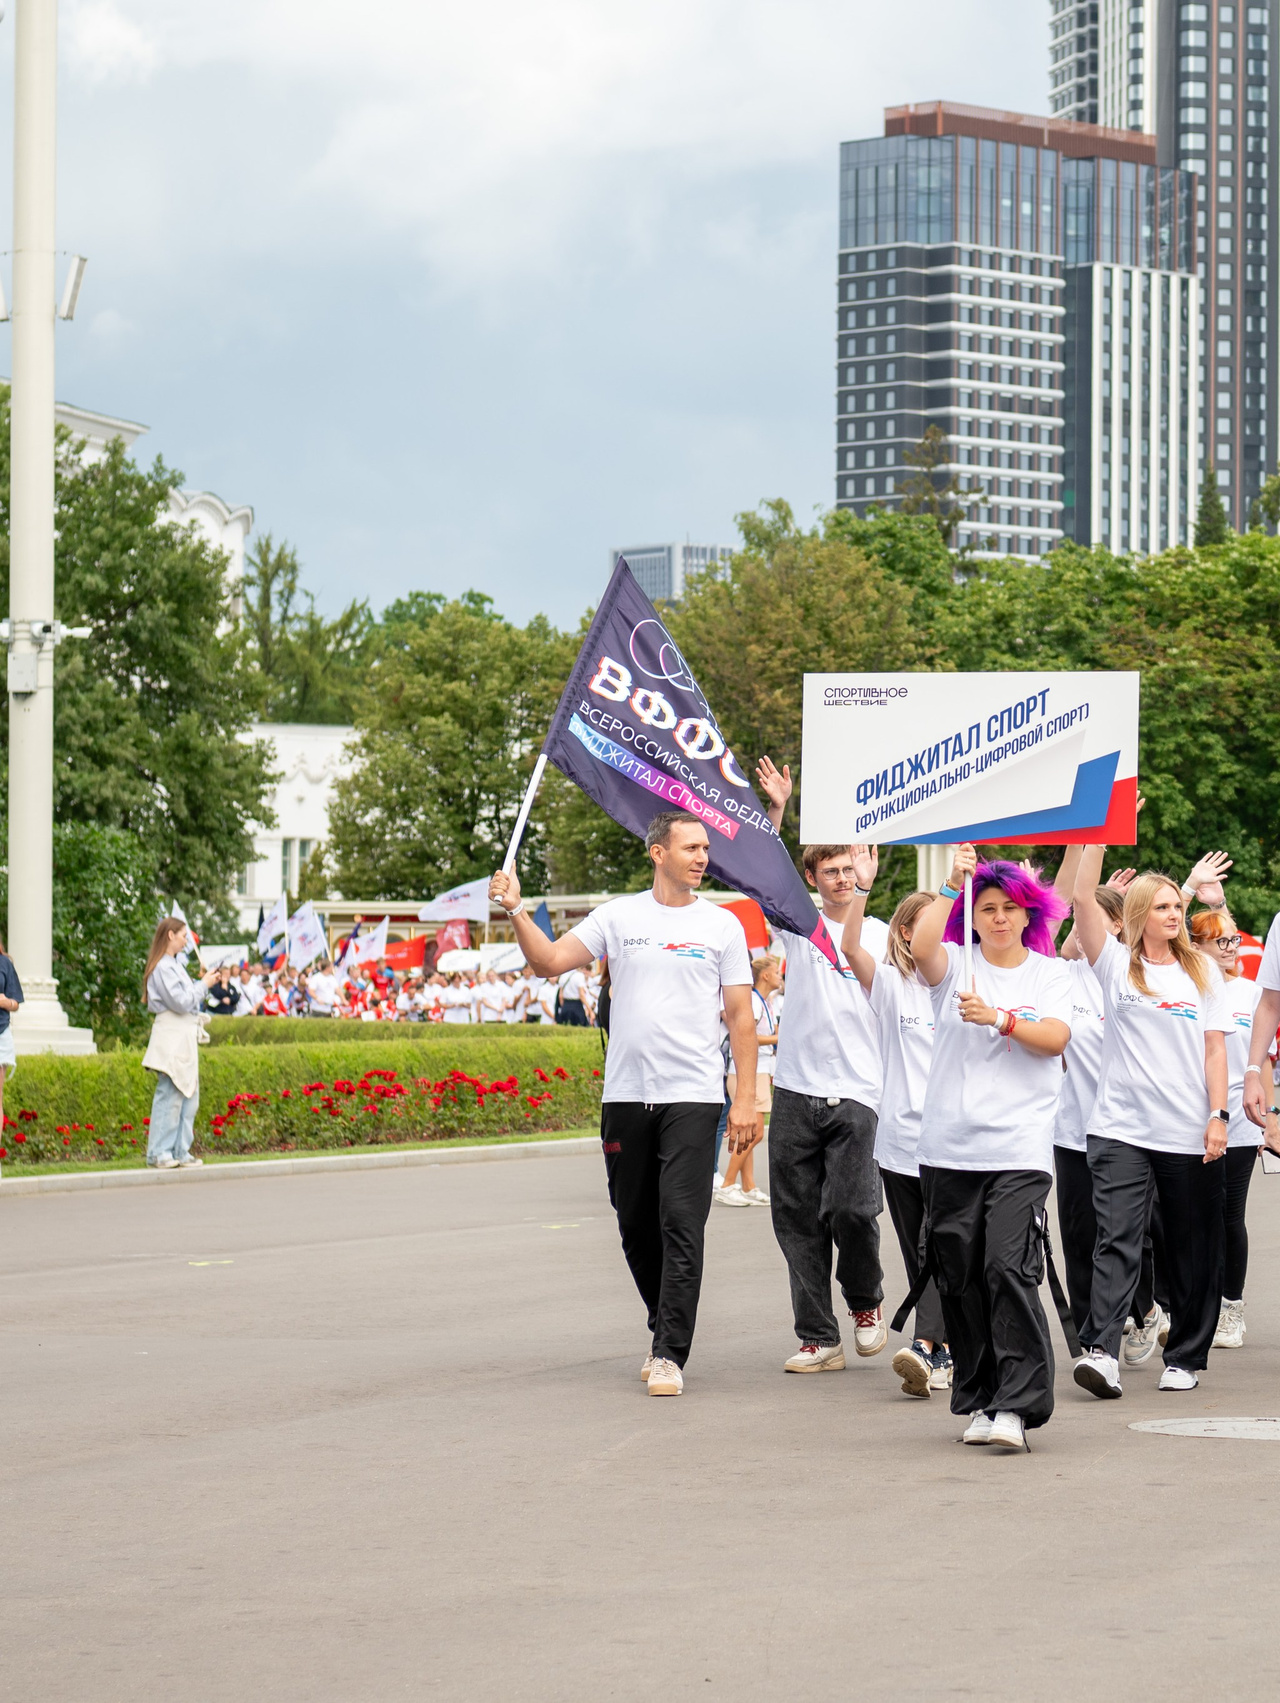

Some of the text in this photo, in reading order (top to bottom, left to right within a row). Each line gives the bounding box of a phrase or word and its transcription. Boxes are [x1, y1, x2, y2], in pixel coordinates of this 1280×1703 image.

[578, 700, 721, 803] ВСЕРОССИЙСКАЯ
[855, 702, 1090, 833] (ФУНКЦИОНАЛЬНО-ЦИФРОВОЙ СПОРТ)
[856, 687, 1051, 807] ФИДЖИТАЛ СПОРТ
[668, 784, 732, 835] СПОРТА
